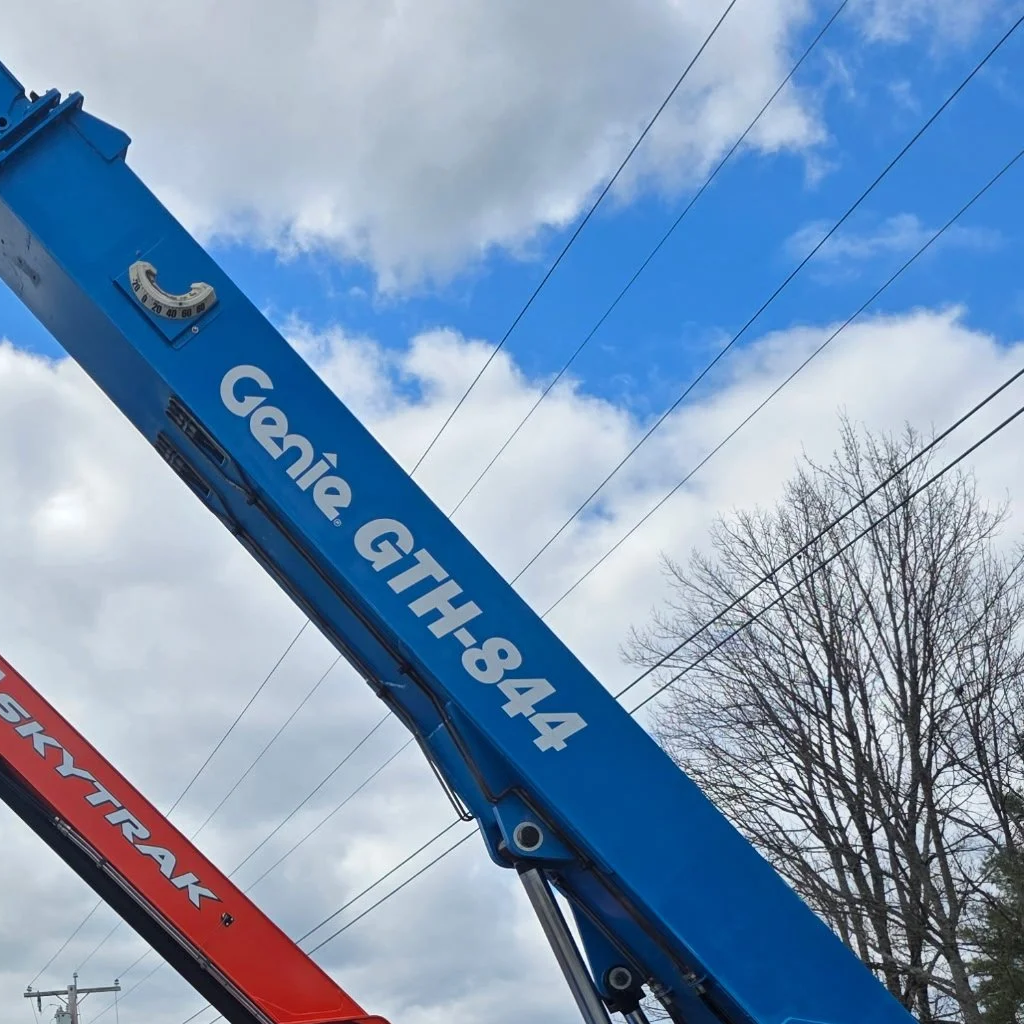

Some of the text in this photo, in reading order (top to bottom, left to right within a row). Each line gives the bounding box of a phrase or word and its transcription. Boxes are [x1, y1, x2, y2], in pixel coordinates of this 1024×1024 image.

[151, 303, 162, 313] 20
[167, 309, 176, 318] 40
[182, 309, 192, 317] 60
[219, 364, 589, 753] Genie GTH-844
